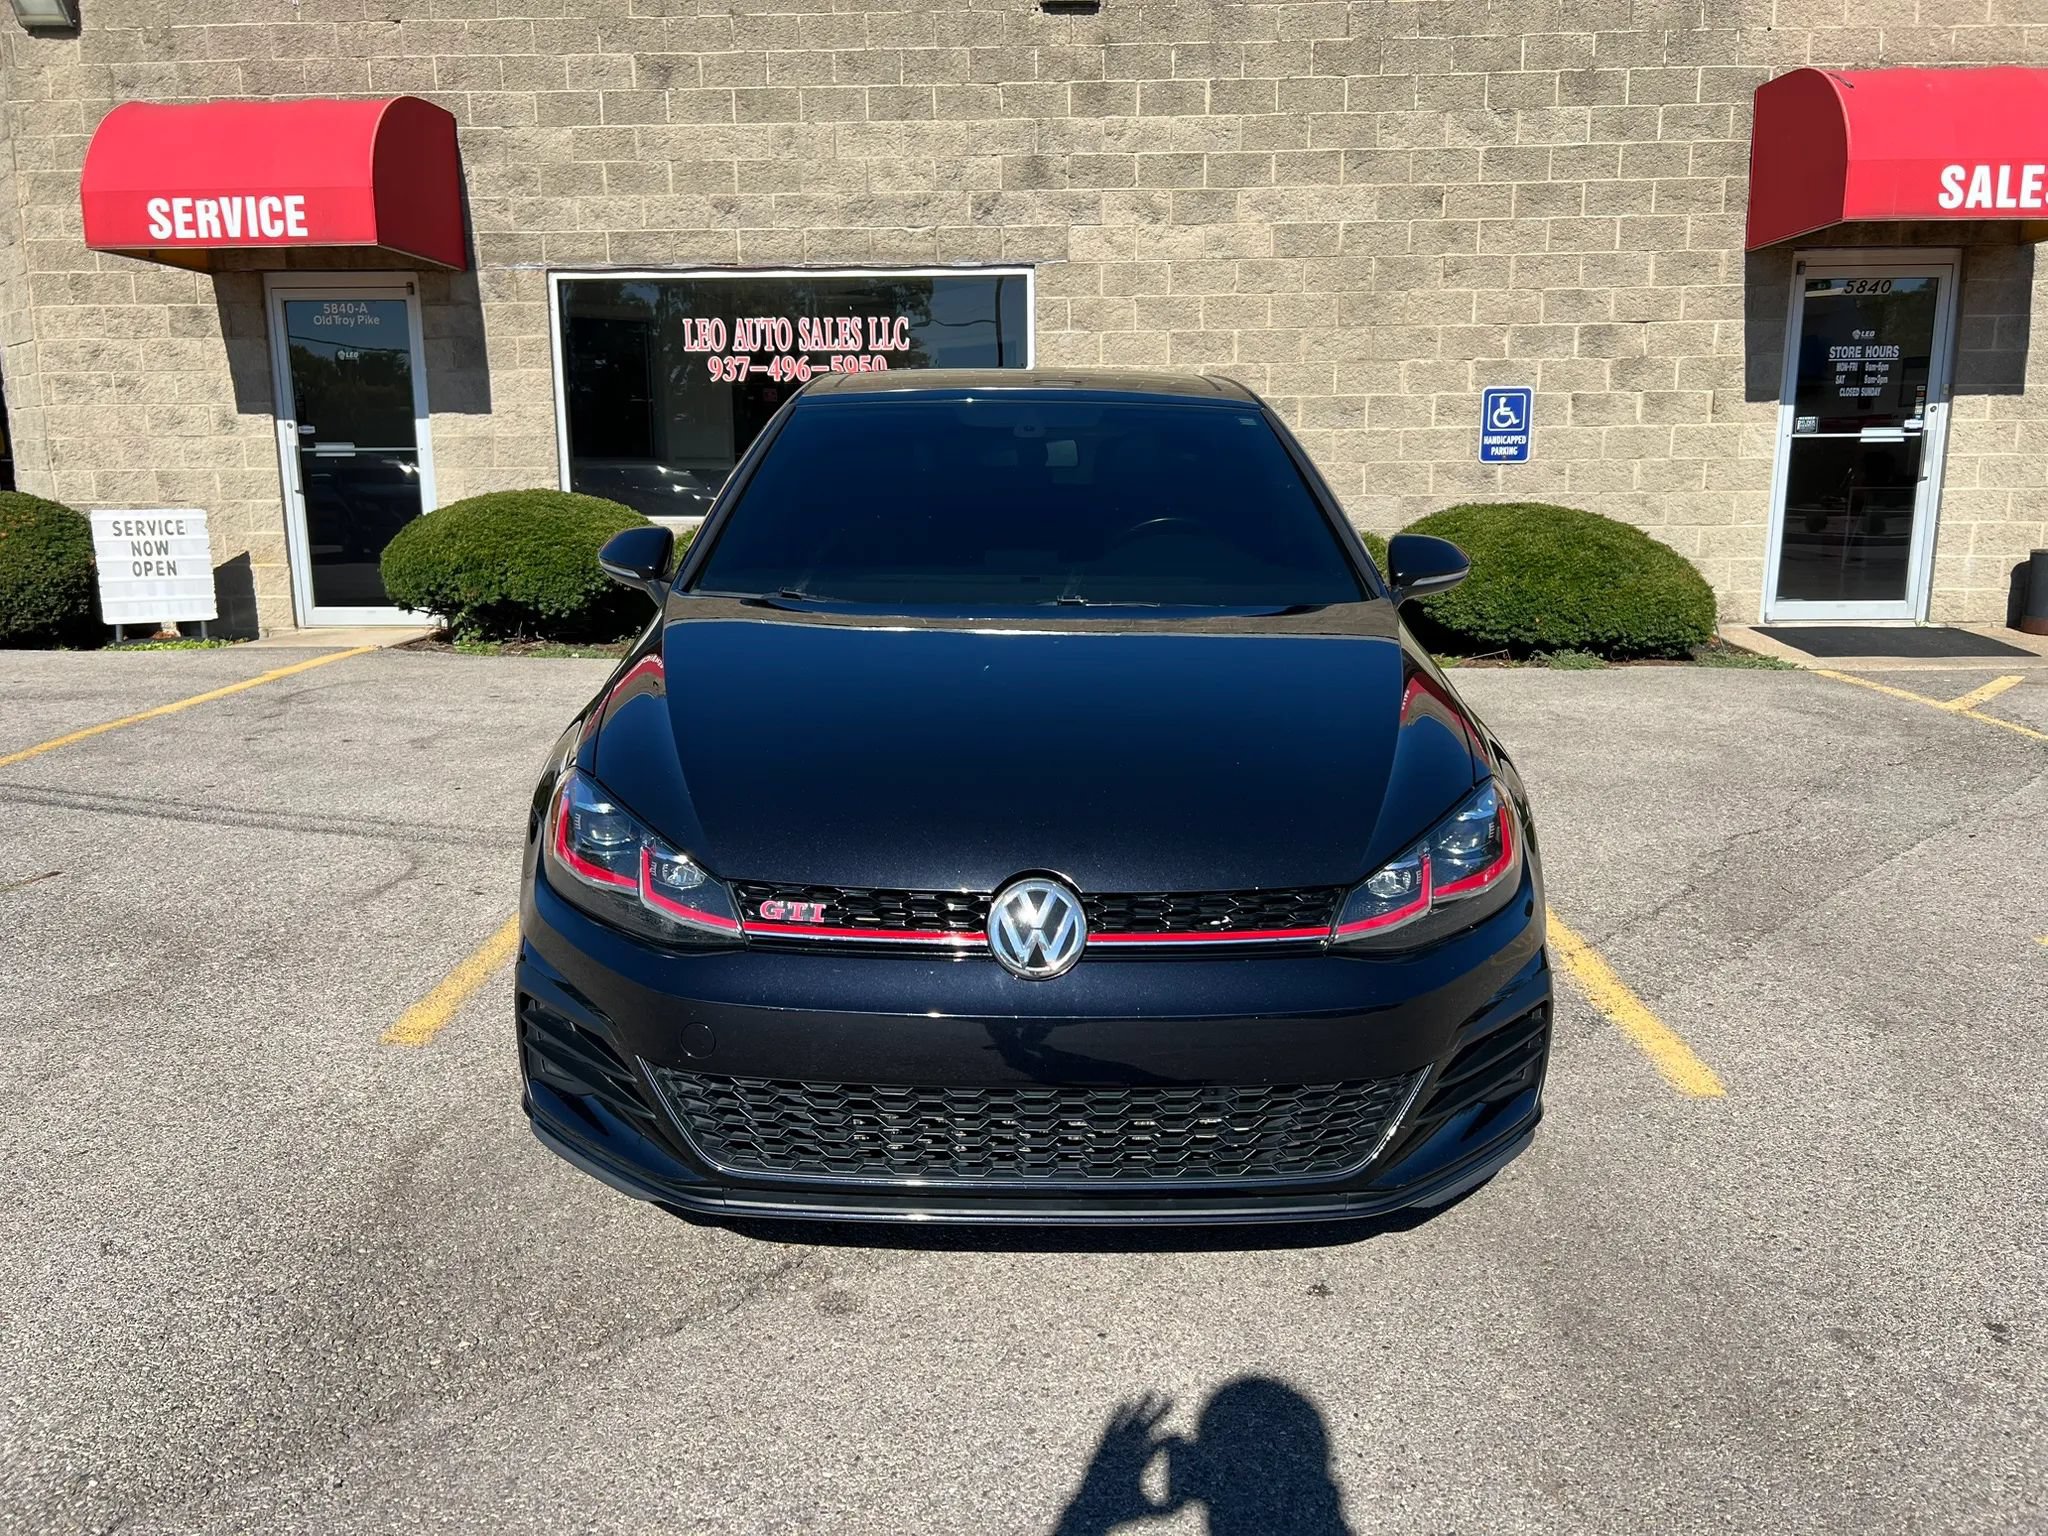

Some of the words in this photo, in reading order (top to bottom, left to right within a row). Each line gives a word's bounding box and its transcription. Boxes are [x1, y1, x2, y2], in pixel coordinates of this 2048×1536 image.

[1938, 164, 2048, 209] SALE
[147, 195, 308, 240] SERVICE
[1844, 280, 1892, 294] 5840
[323, 303, 368, 314] 5840-A
[313, 315, 332, 325] Old
[334, 315, 355, 327] Troy
[357, 315, 380, 325] Pike
[682, 318, 727, 351] LEO
[732, 317, 793, 351] AUTO
[798, 317, 862, 351] SALES
[867, 316, 910, 350] LLC
[1829, 346, 1862, 358] STORE
[1865, 345, 1900, 358] HOURS
[1839, 387, 1860, 396] CLOSED
[1861, 387, 1882, 396] SUNDAY
[1483, 435, 1527, 444] HANDICAPPED
[1490, 446, 1519, 455] PARKING
[112, 520, 185, 536] SERVICE
[131, 540, 169, 556] NOW
[132, 560, 178, 576] OPEN
[760, 900, 826, 922] GTI
